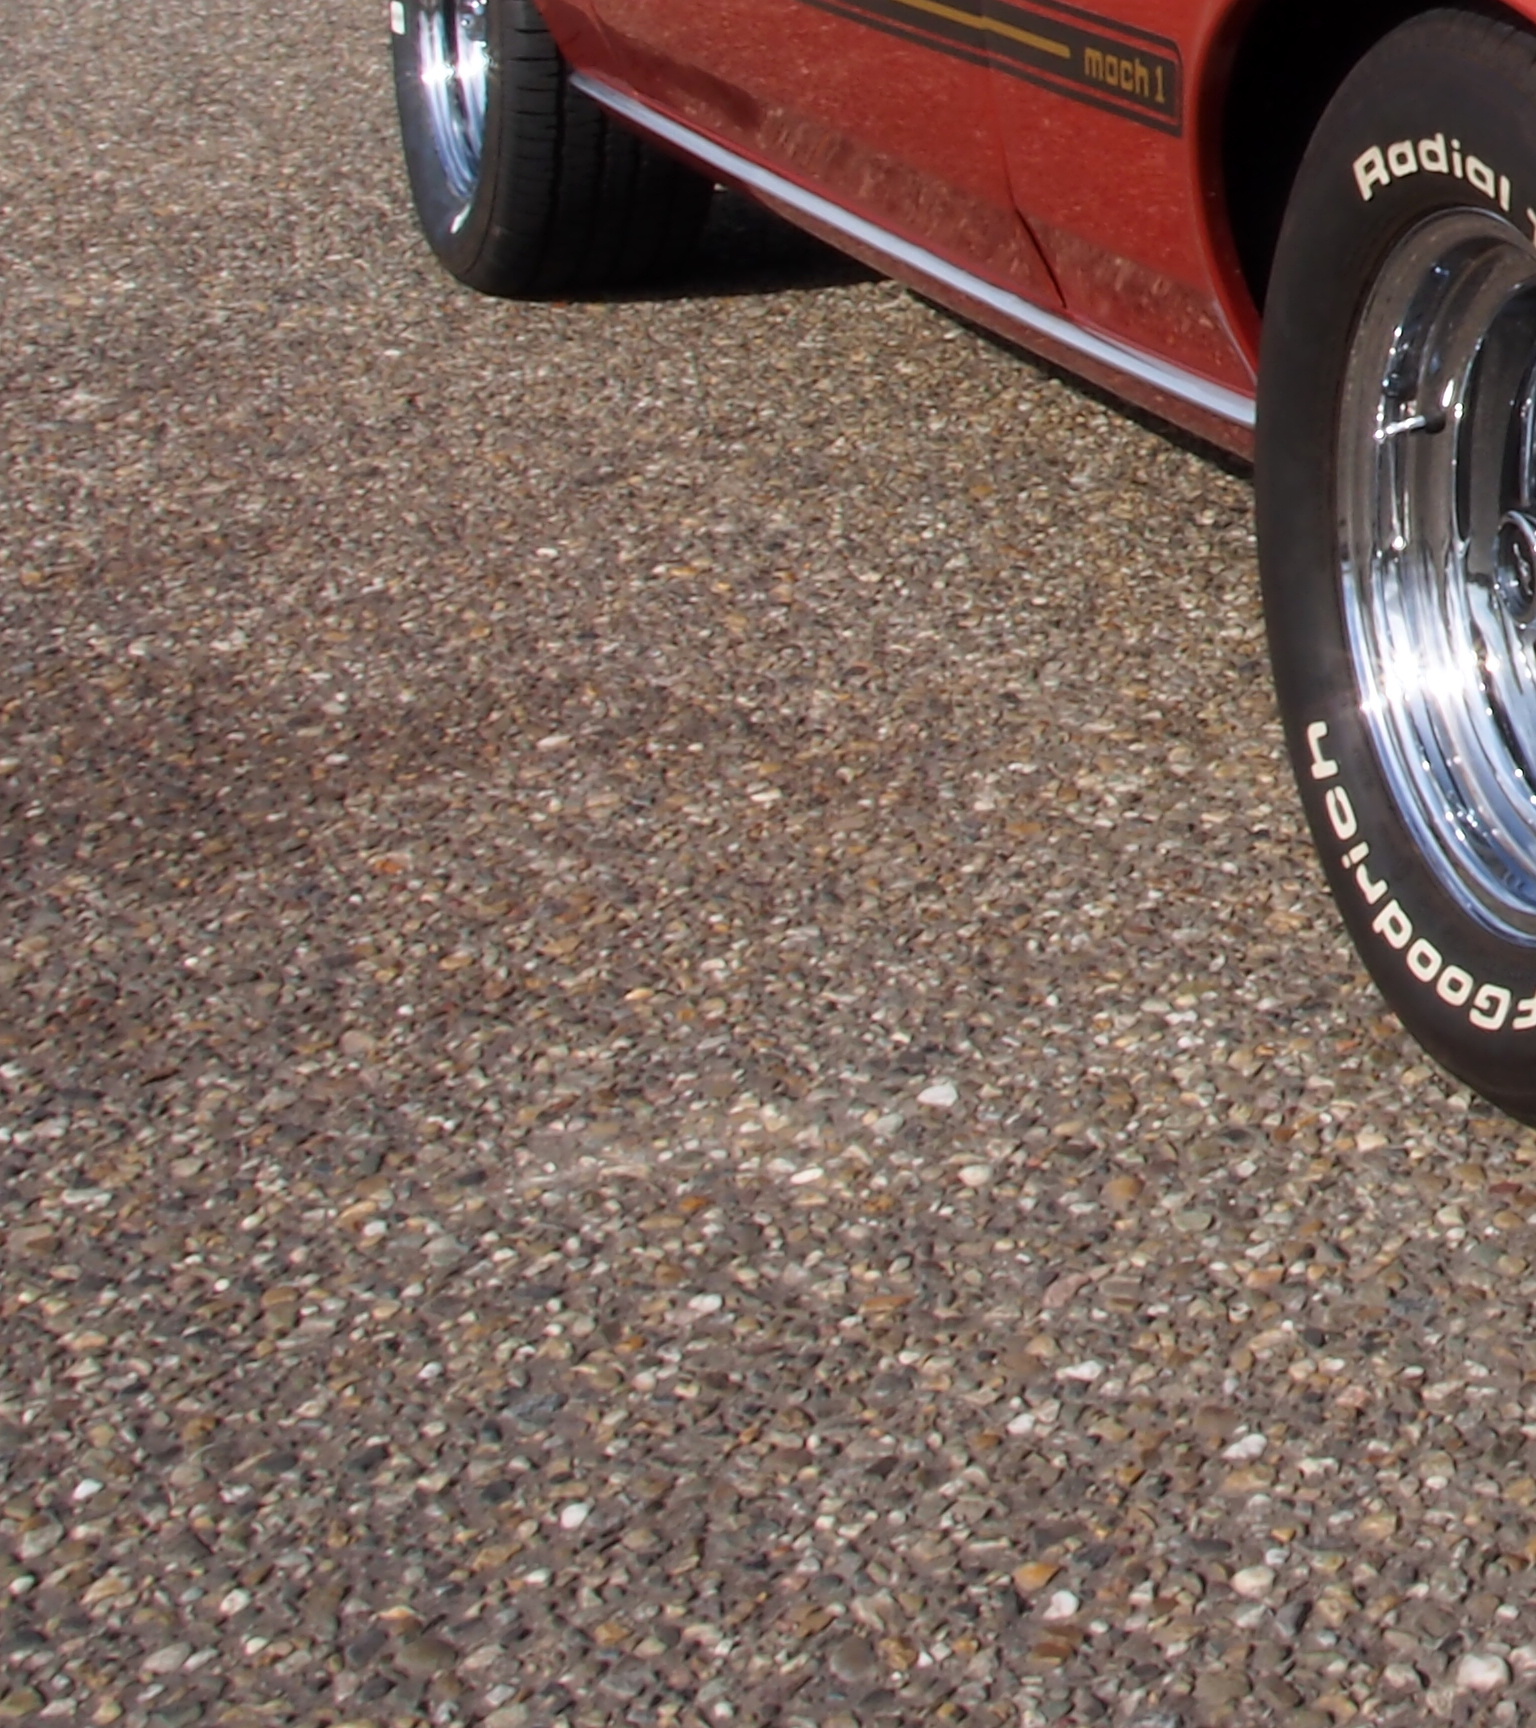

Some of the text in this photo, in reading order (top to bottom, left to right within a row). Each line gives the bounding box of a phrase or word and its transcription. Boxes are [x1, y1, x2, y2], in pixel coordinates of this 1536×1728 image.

[1084, 46, 1167, 105] mach 1
[1352, 132, 1512, 212] Radial
